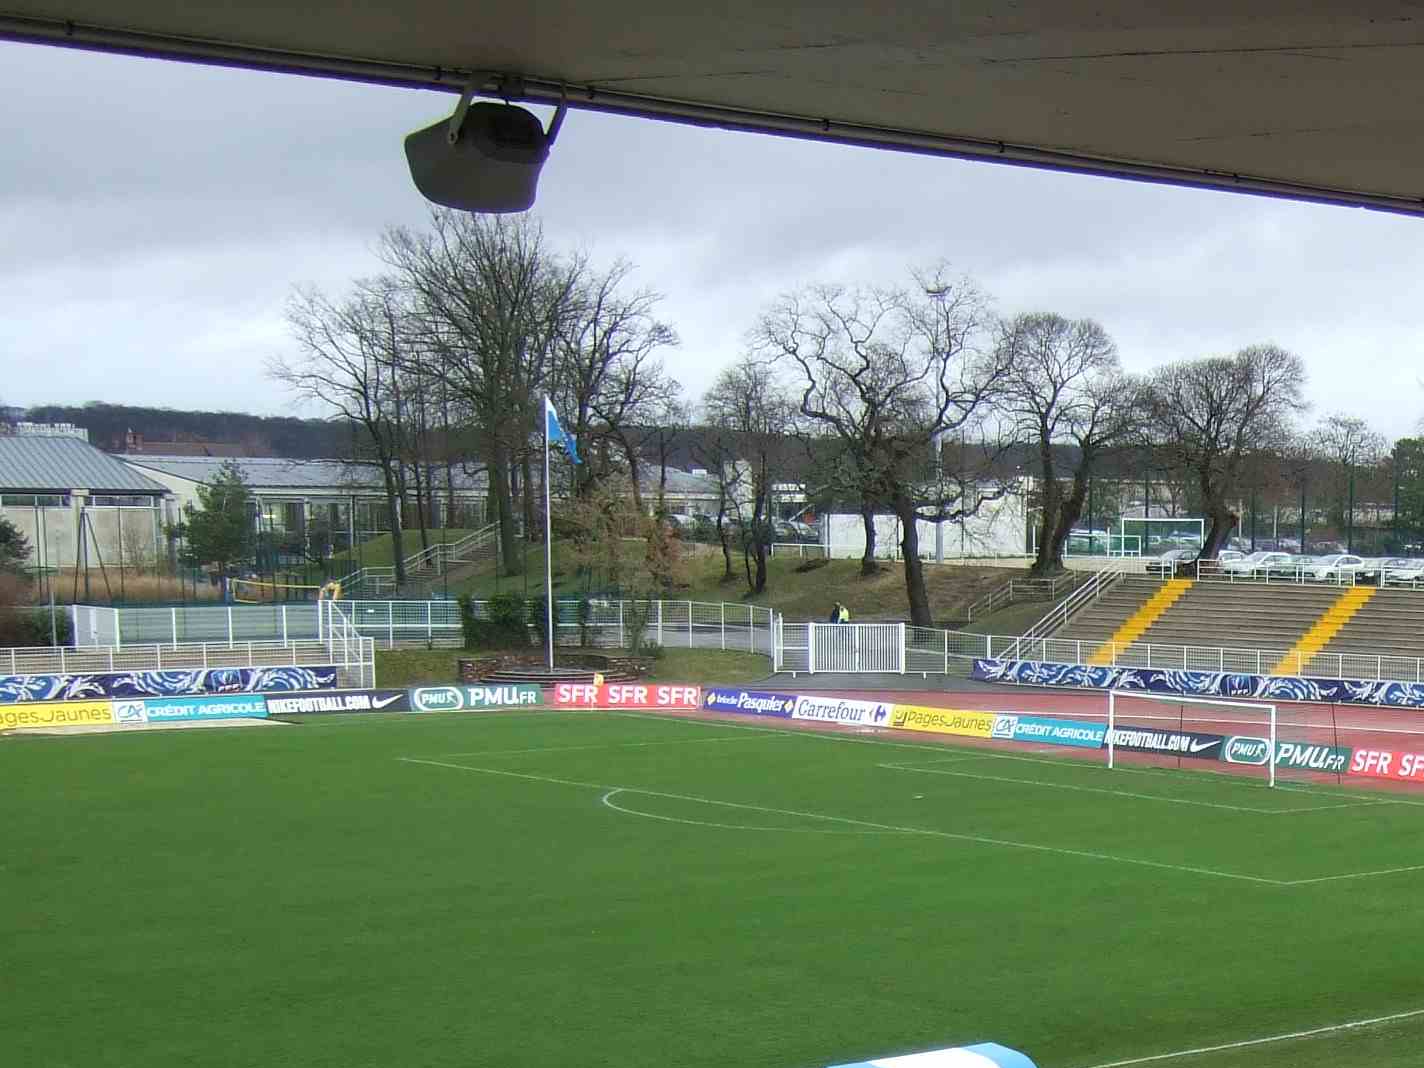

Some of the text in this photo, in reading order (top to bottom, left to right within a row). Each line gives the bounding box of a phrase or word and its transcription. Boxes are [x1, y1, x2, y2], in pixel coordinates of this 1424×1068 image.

[267, 694, 371, 714] NIKEFOOTBALL.COM
[557, 685, 697, 706] SFR SFR SFR
[737, 692, 785, 713] Pasquier
[198, 701, 266, 715] AGRICOLE
[799, 699, 867, 722] Carrefour
[907, 709, 993, 732] PagesJaunes
[1052, 725, 1104, 742] AGRICOLE
[1351, 749, 1393, 774] SFR
